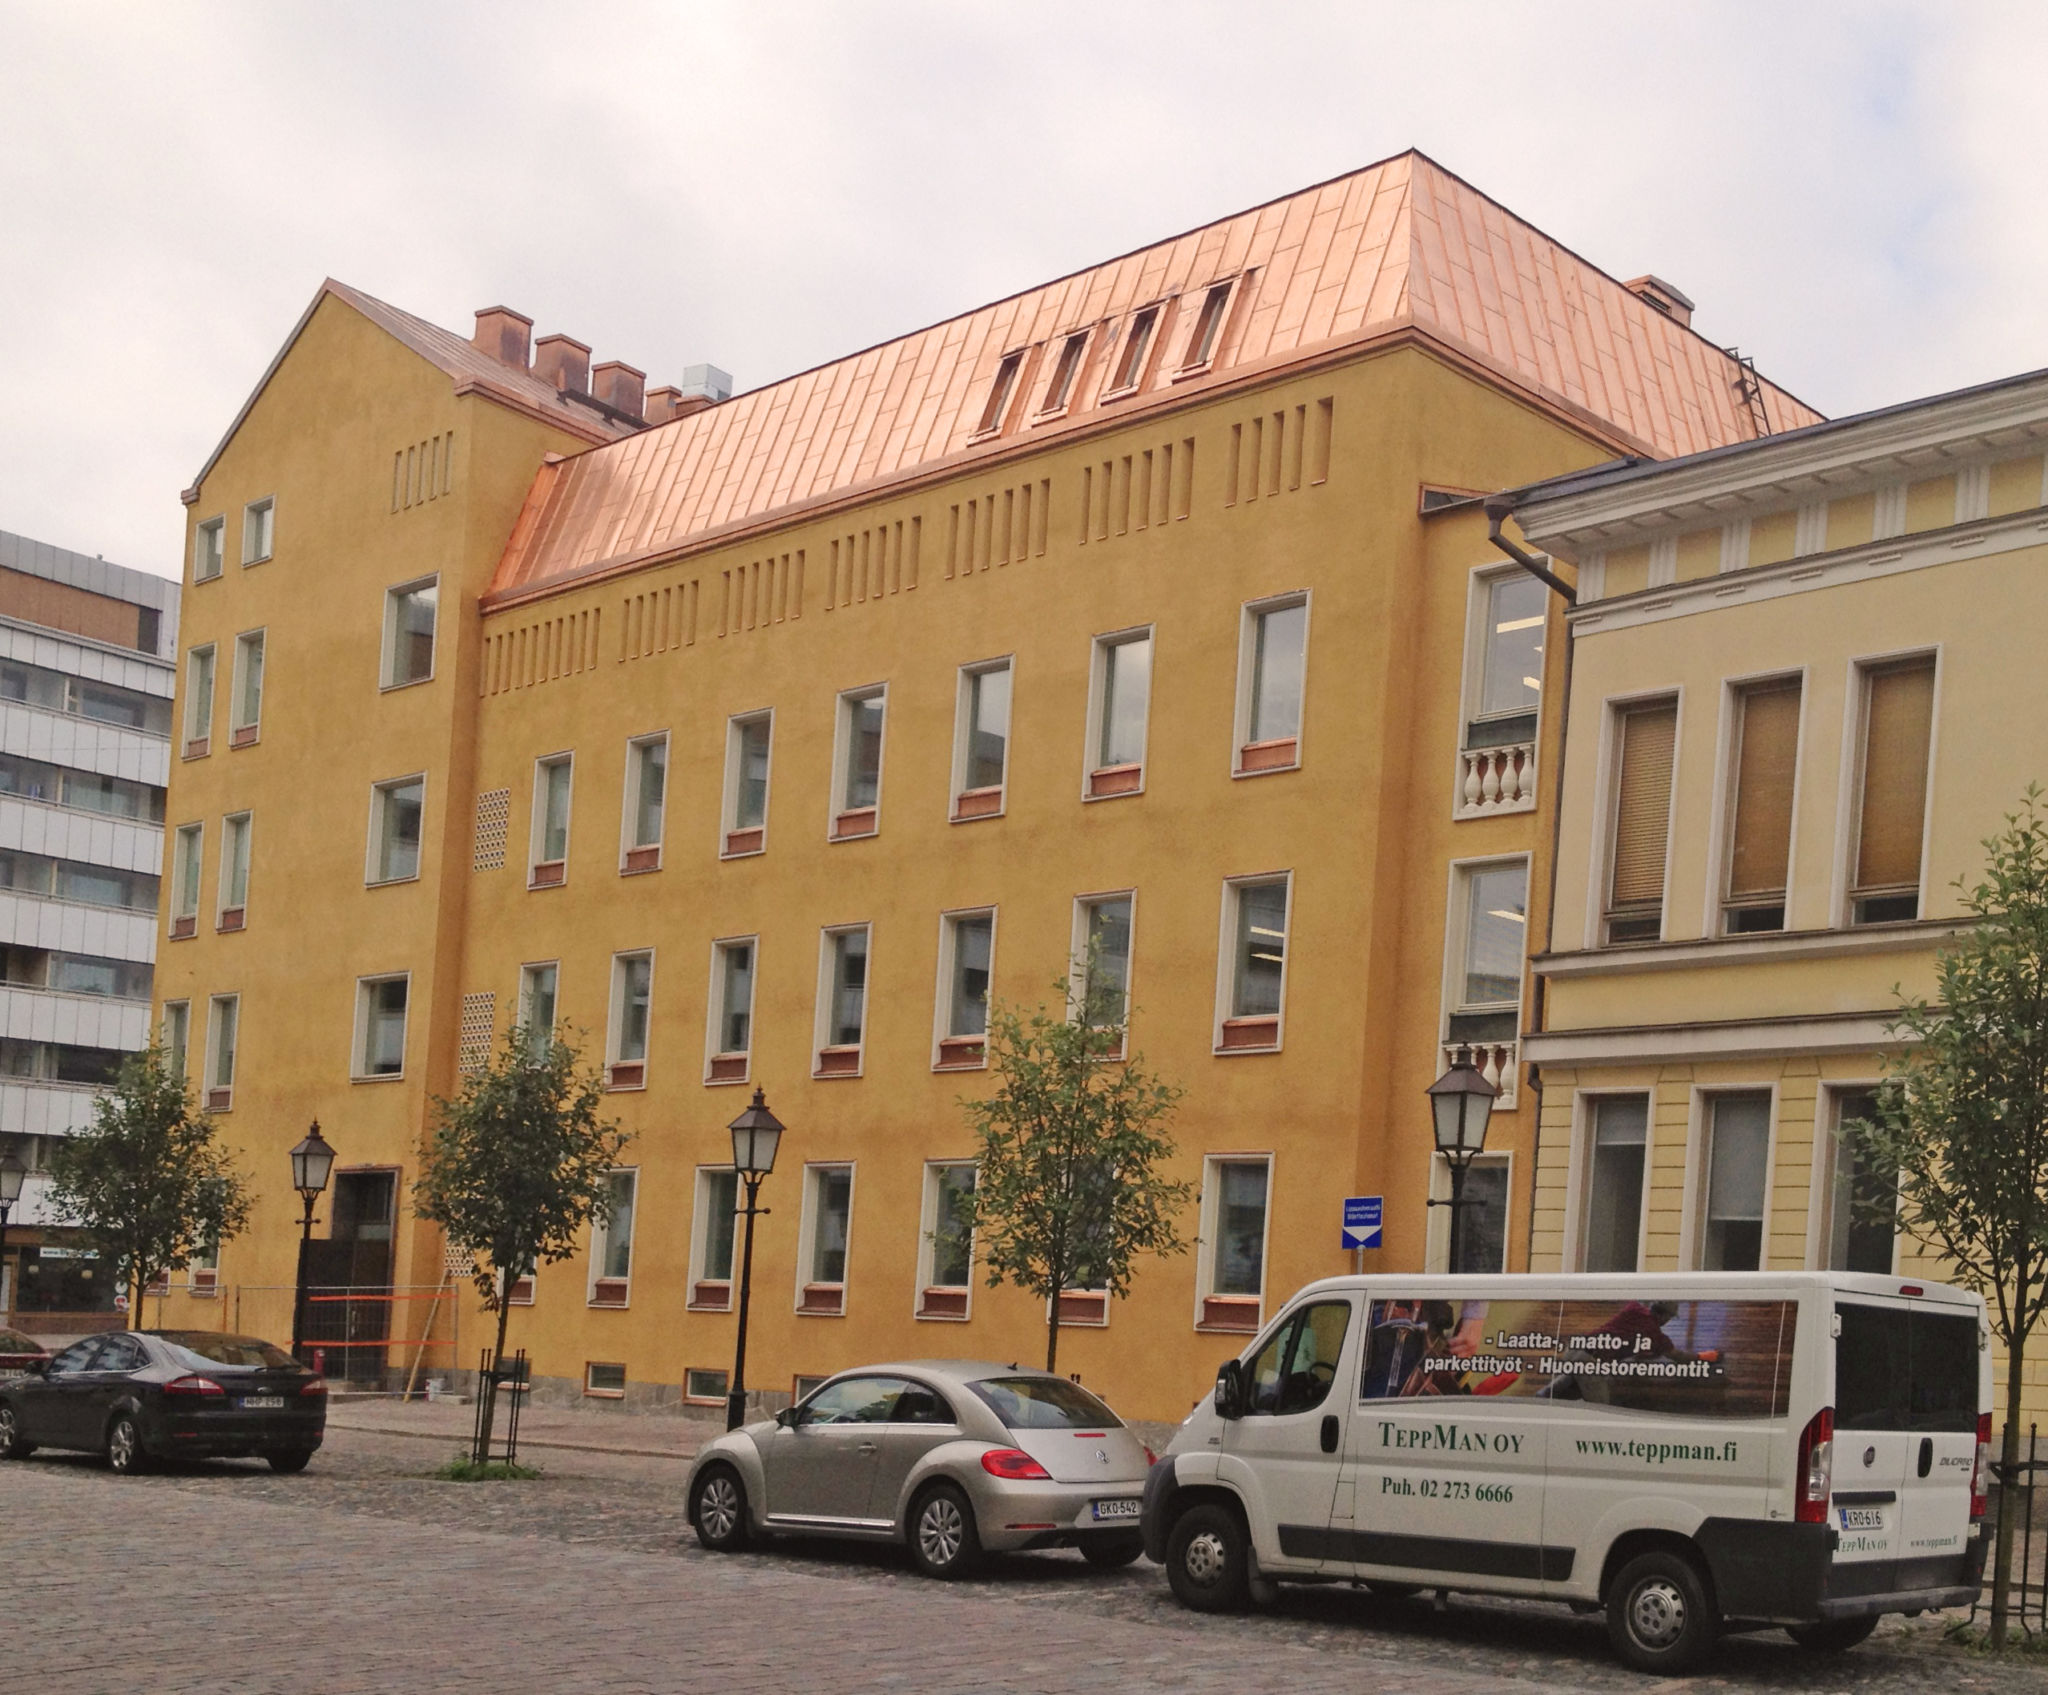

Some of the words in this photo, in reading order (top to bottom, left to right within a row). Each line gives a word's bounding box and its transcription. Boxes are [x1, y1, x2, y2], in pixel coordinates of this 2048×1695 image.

[1497, 1331, 1564, 1351] Laatta-,
[1569, 1333, 1629, 1350] matto-
[1633, 1333, 1652, 1353] ja
[1423, 1355, 1522, 1376] parkettityöt
[1539, 1357, 1710, 1378] Huoneistoremontit
[1493, 1433, 1525, 1454] OY
[1575, 1439, 1738, 1464] www.teppman.fi
[1382, 1476, 1416, 1497] Puh.
[1420, 1479, 1439, 1498] 02
[1443, 1481, 1471, 1500] 273
[1475, 1483, 1514, 1504] 6666
